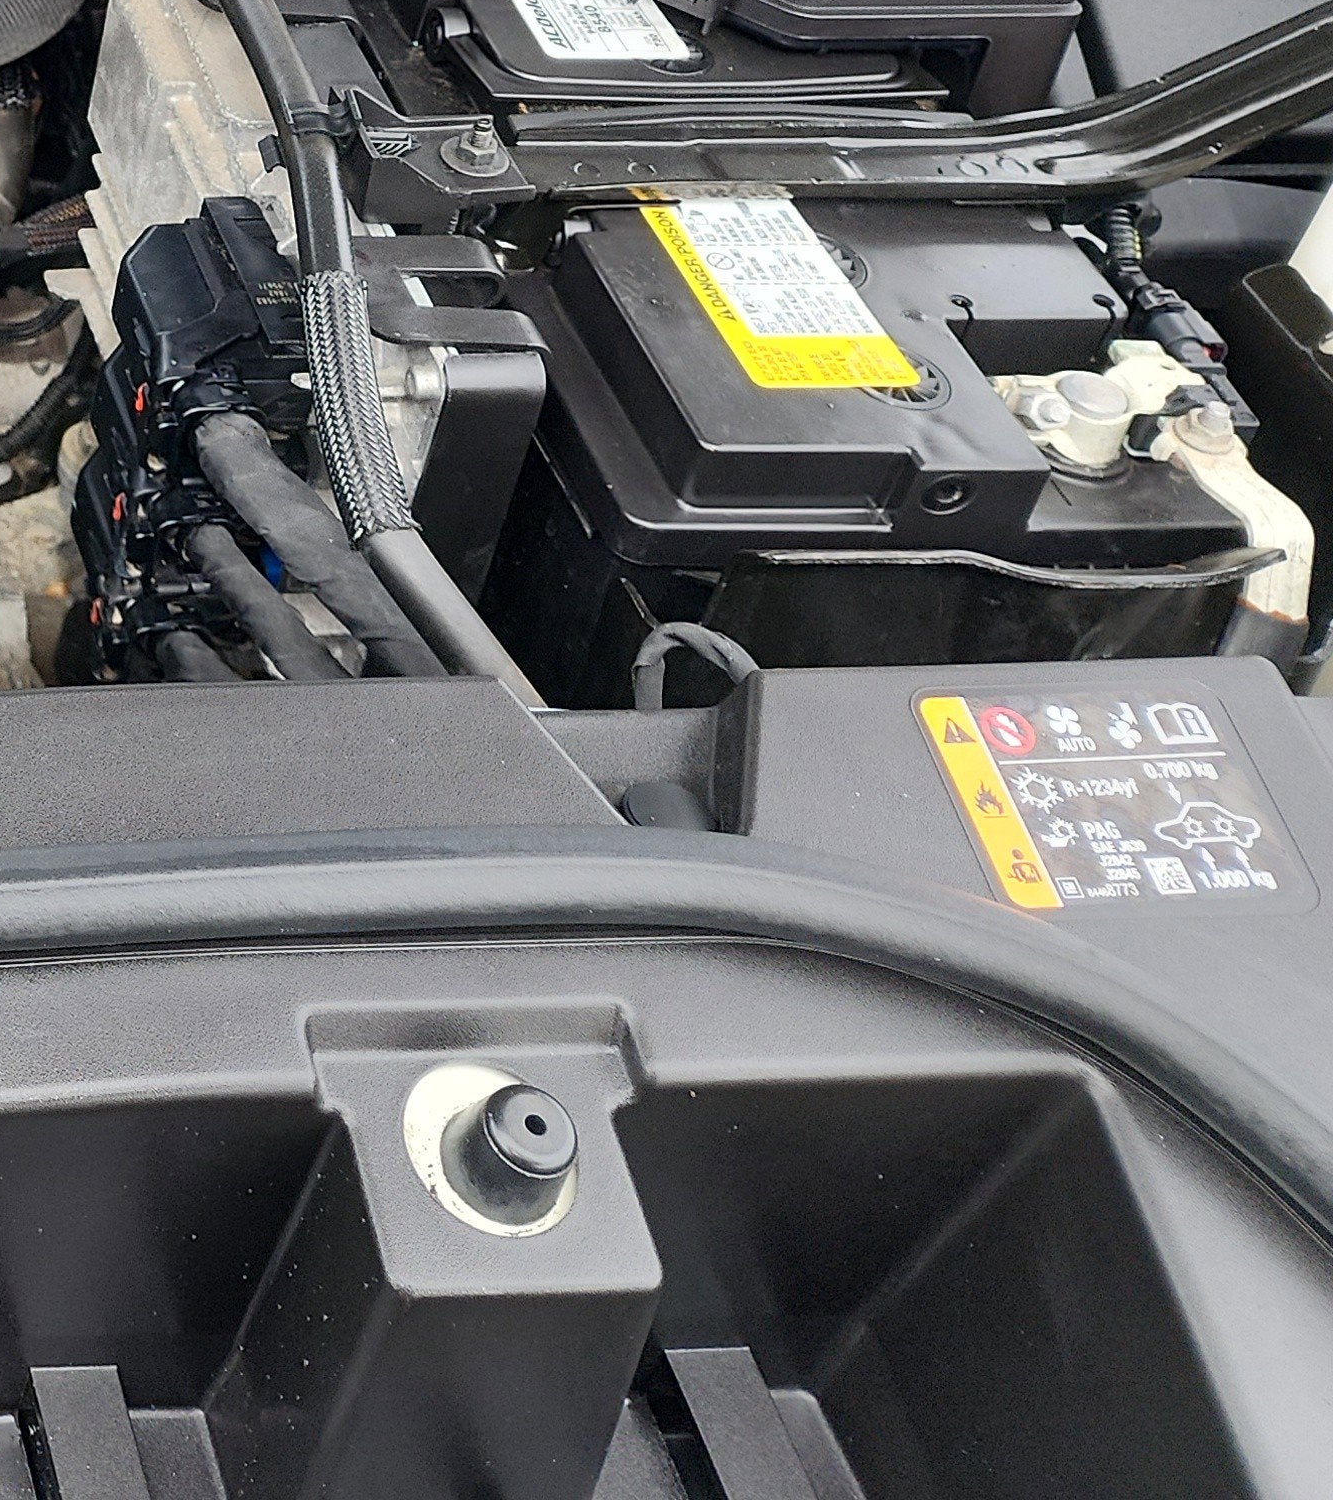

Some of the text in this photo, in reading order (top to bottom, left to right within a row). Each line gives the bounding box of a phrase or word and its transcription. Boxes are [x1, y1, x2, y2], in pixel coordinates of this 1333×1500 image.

[1058, 736, 1097, 752] AUTO
[1143, 760, 1219, 781] 0.700 kg
[1061, 777, 1140, 799] R-1234yf
[1081, 820, 1123, 840] PAG
[1090, 840, 1118, 854] SAE
[1196, 867, 1279, 890] 1.000 kg
